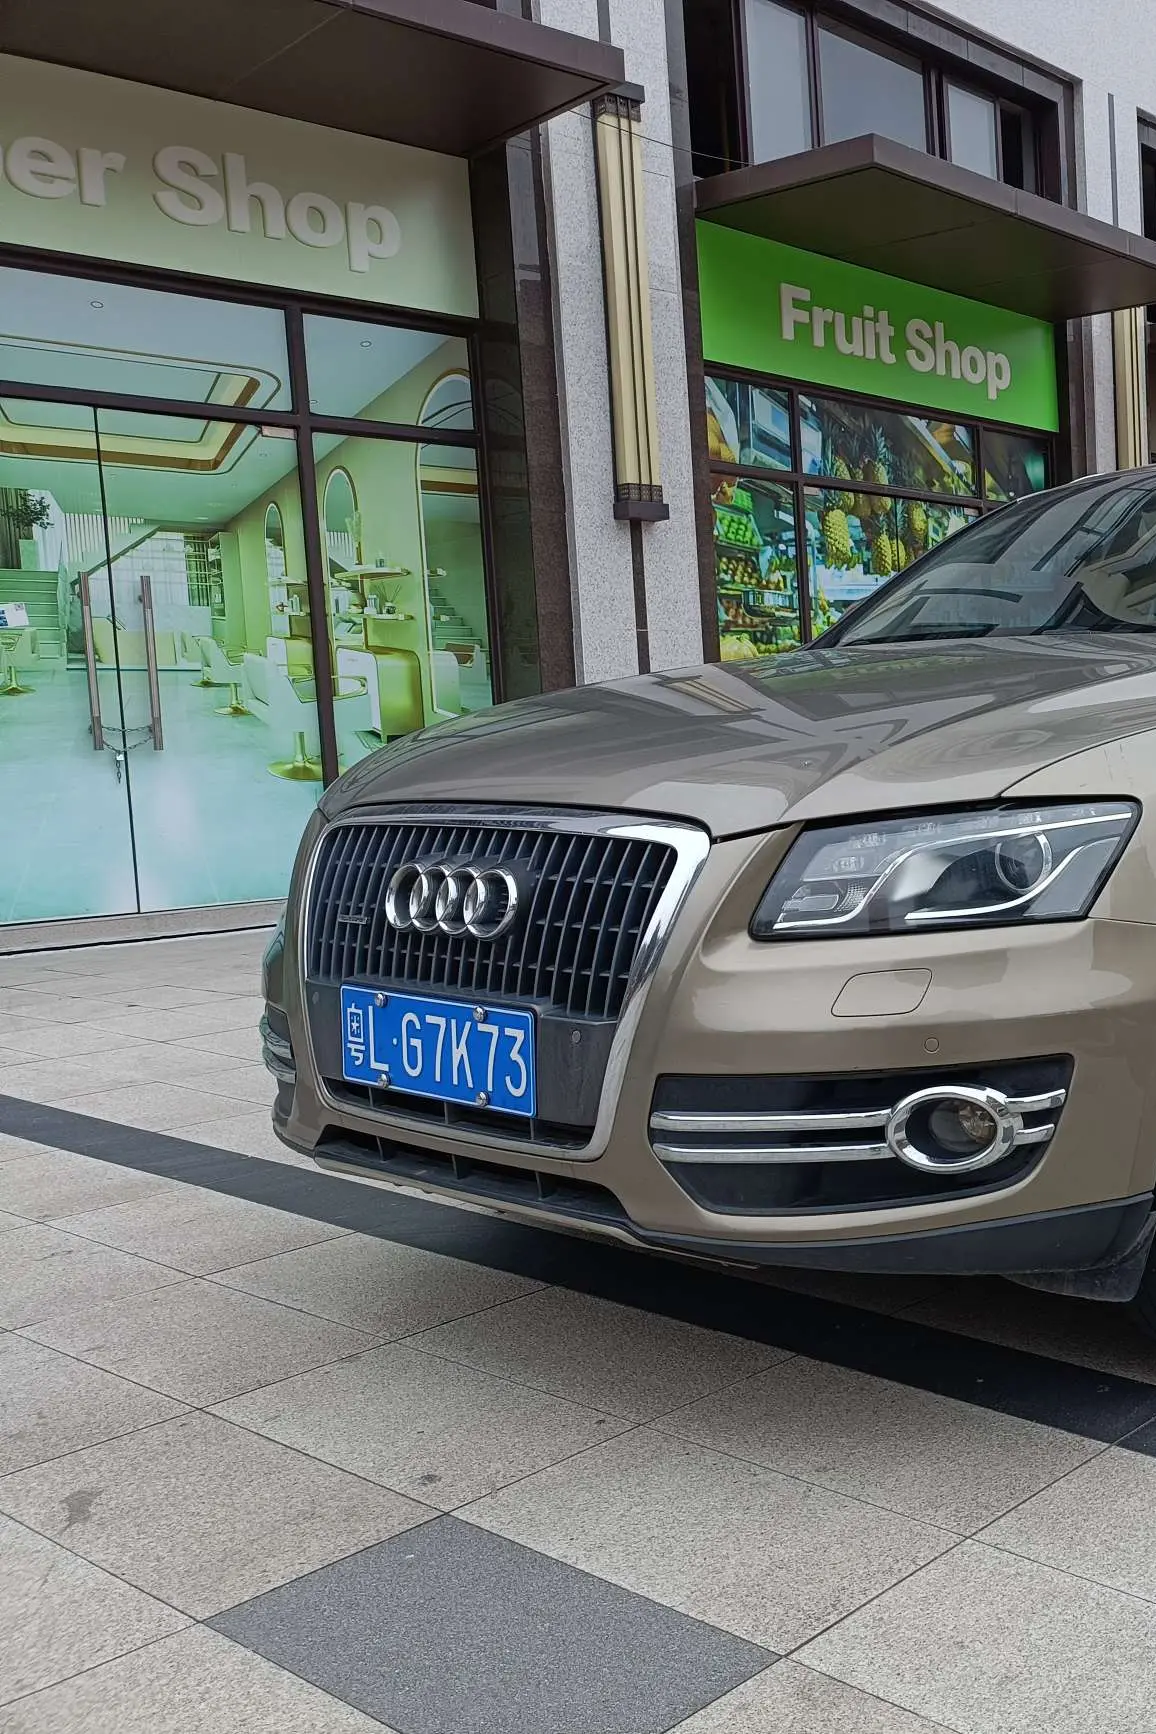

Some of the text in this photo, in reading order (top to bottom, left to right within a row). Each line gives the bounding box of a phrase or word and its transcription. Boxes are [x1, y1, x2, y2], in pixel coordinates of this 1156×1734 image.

[0, 136, 402, 273] er Shop
[780, 282, 1011, 400] Fruit Shop
